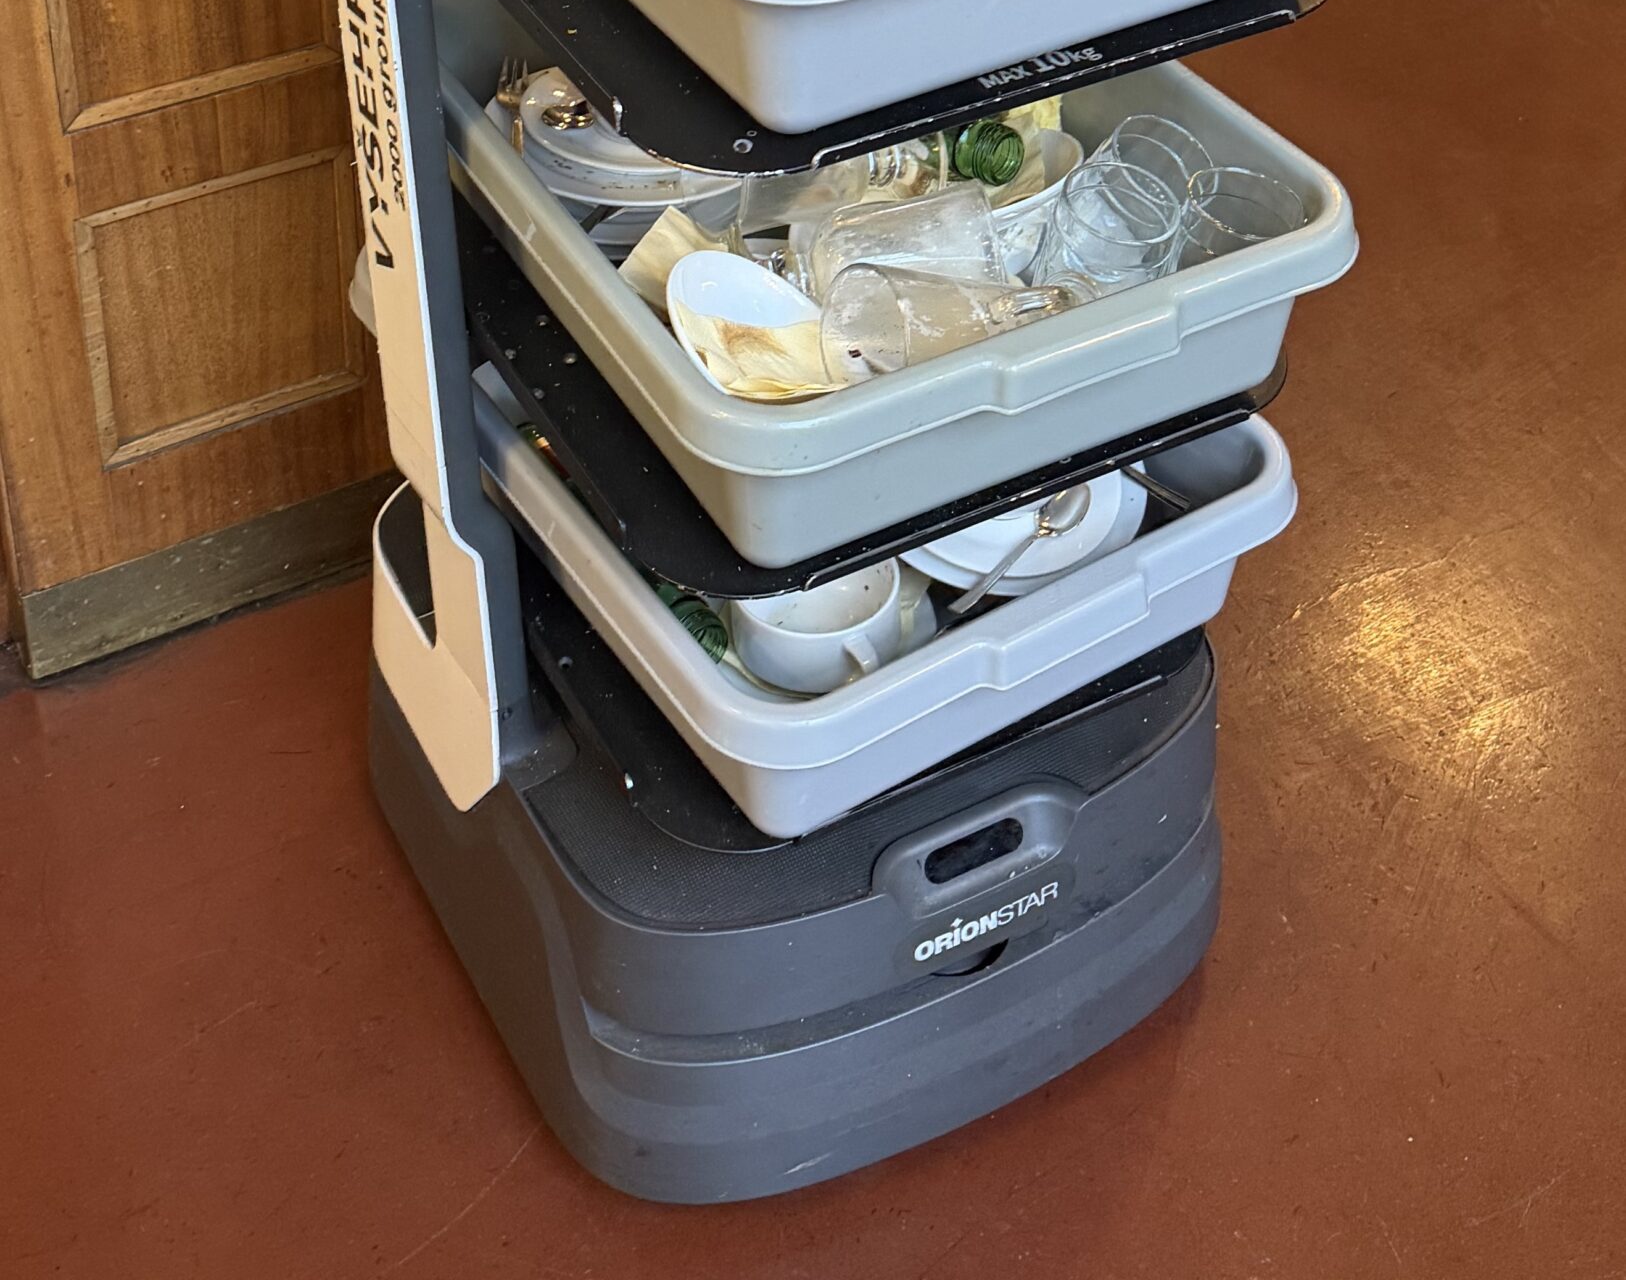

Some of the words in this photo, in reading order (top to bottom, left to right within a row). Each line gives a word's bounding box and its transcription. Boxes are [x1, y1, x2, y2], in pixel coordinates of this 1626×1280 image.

[977, 65, 1034, 89] MAX
[1028, 47, 1103, 73] 10kg
[383, 119, 405, 211] 2000
